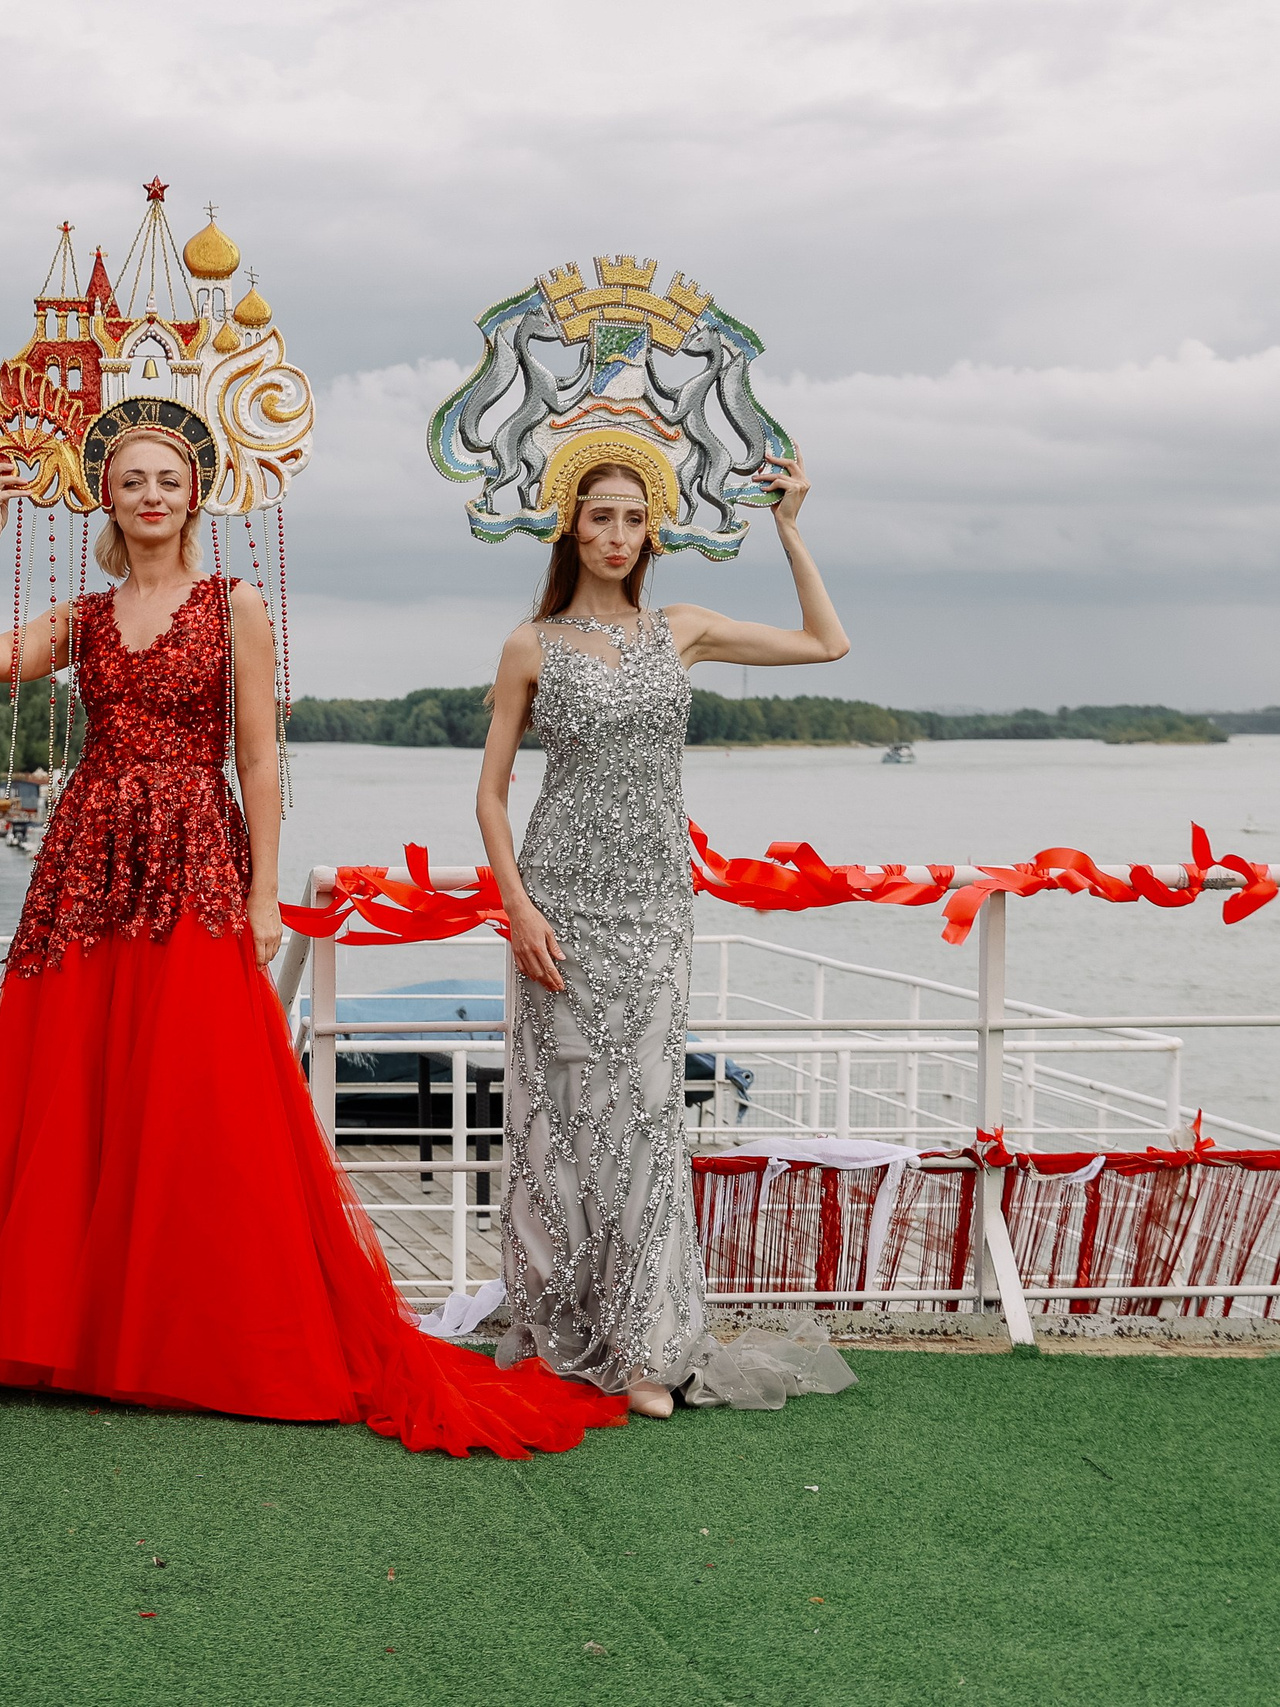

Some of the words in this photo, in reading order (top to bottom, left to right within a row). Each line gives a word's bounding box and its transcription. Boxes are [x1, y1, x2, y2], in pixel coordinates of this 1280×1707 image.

[106, 406, 133, 432] XI
[137, 400, 162, 425] XII
[89, 425, 114, 447] X
